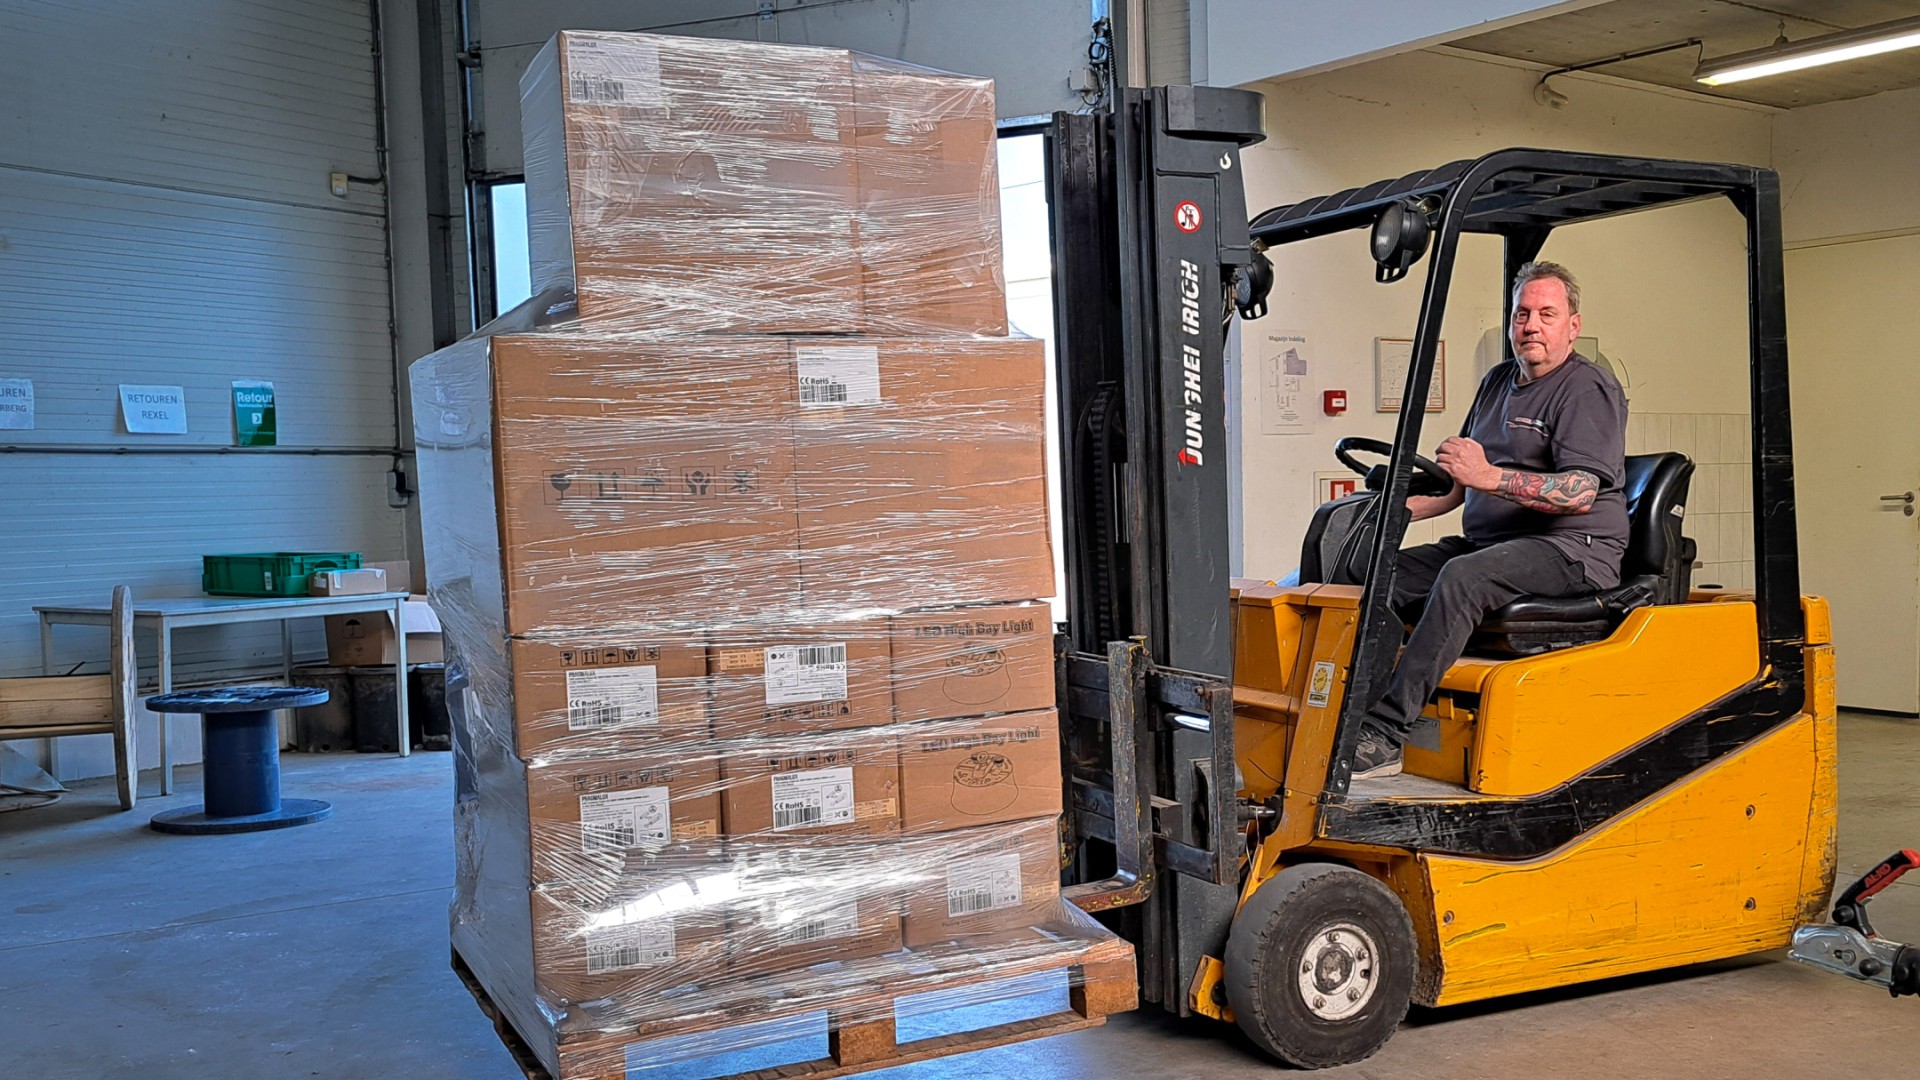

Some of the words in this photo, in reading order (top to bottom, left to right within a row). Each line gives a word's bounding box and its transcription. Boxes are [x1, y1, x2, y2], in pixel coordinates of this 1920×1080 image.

[810, 377, 829, 385] RoHS
[127, 394, 178, 405] RETOUREN
[236, 391, 273, 403] Retour
[142, 410, 169, 420] REXEL
[976, 621, 1000, 636] Bay
[1001, 618, 1034, 634] Light
[581, 699, 602, 708] RoHS
[1006, 726, 1040, 744] Light
[785, 801, 804, 809] RoHS
